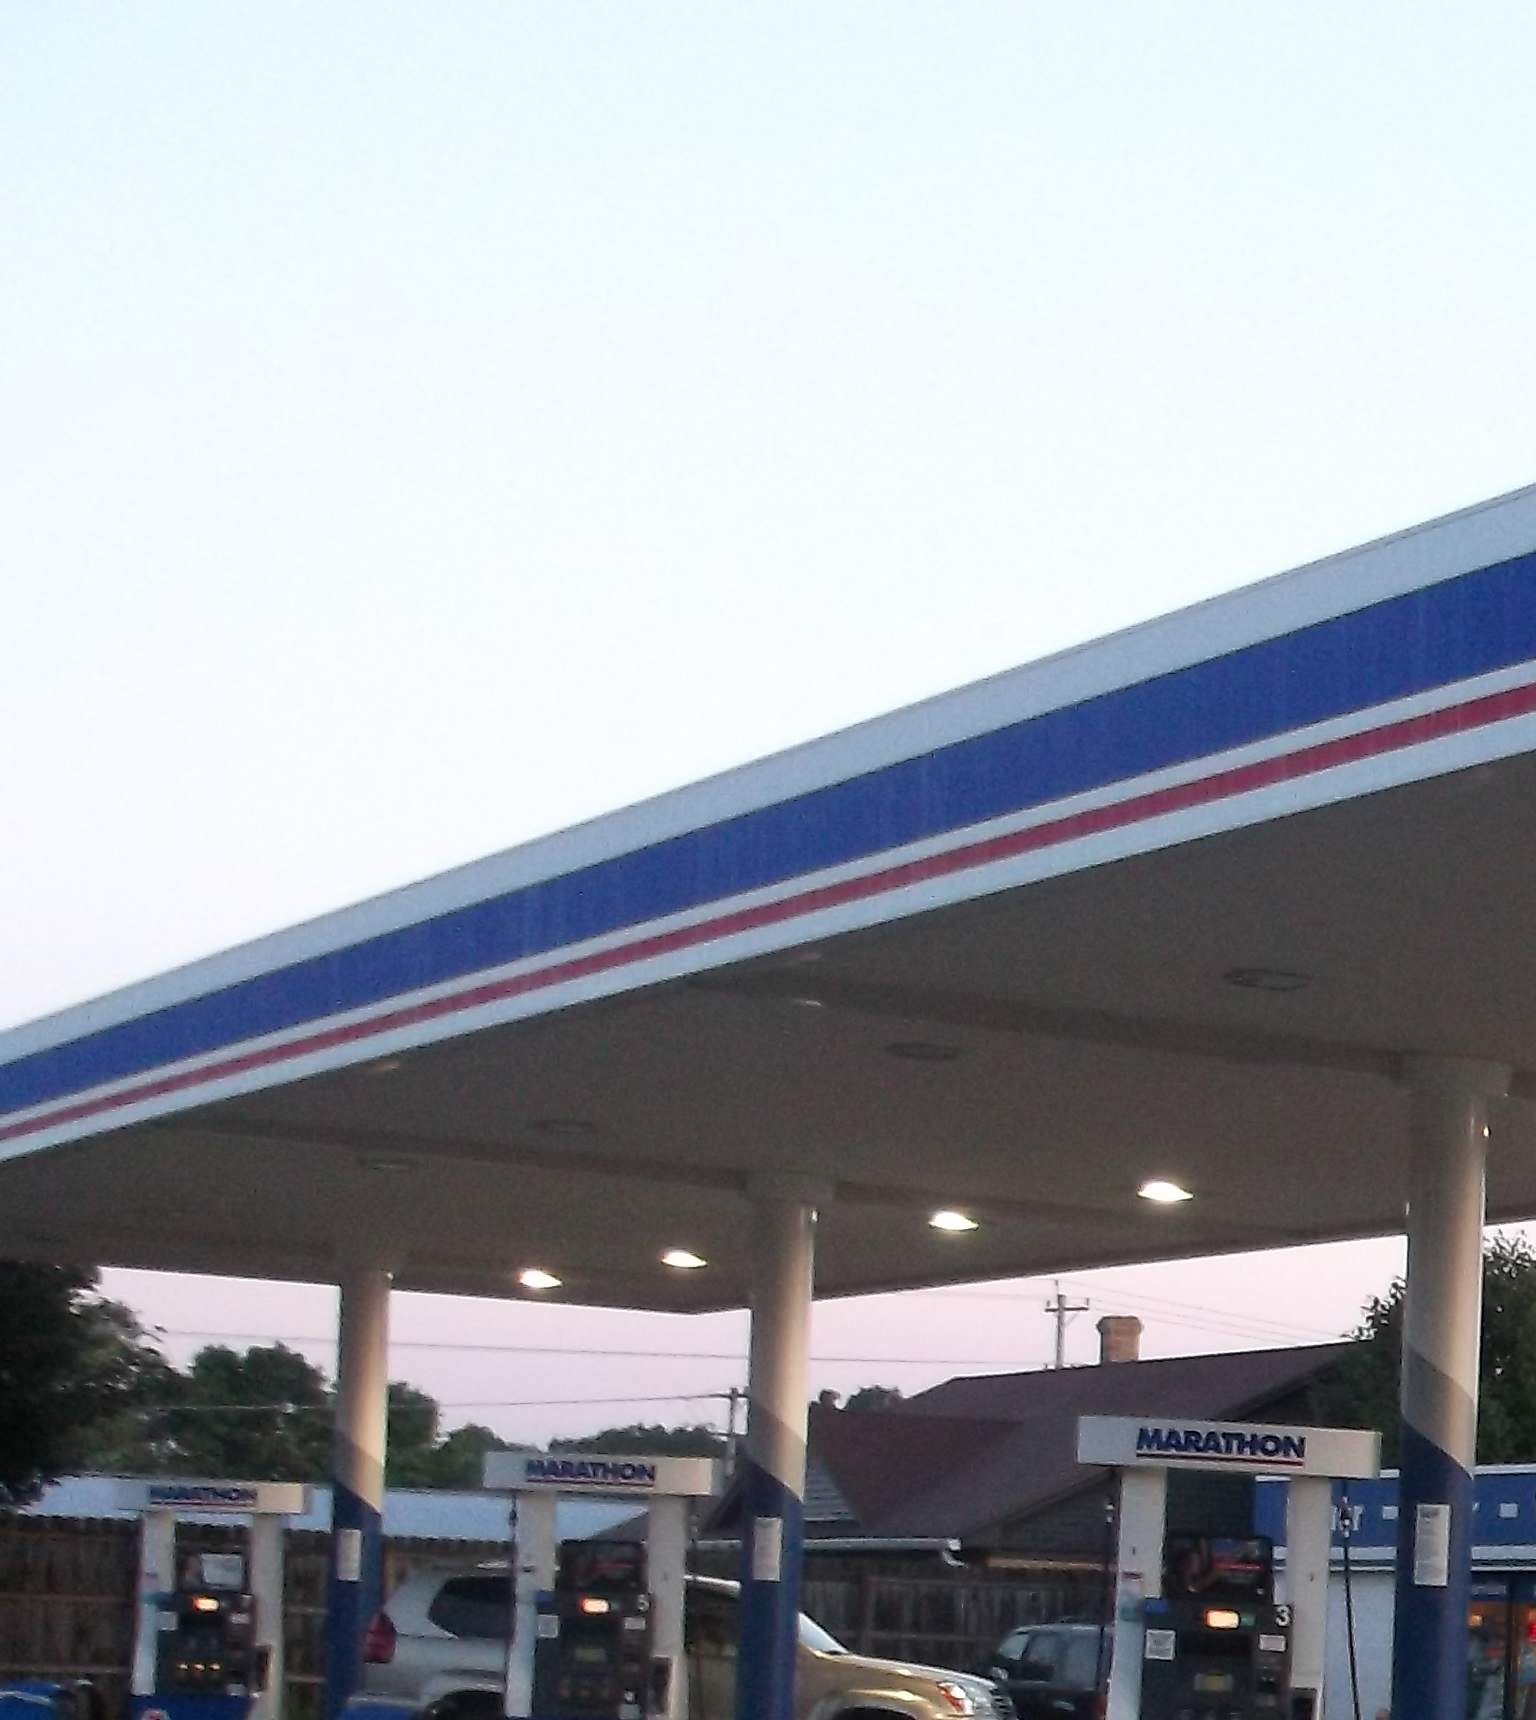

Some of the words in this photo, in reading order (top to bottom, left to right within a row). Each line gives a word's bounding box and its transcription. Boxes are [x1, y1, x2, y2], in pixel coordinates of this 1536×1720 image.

[1136, 1428, 1306, 1458] MARATHON
[526, 1459, 656, 1480] MARATHON
[1275, 1605, 1291, 1627] 3
